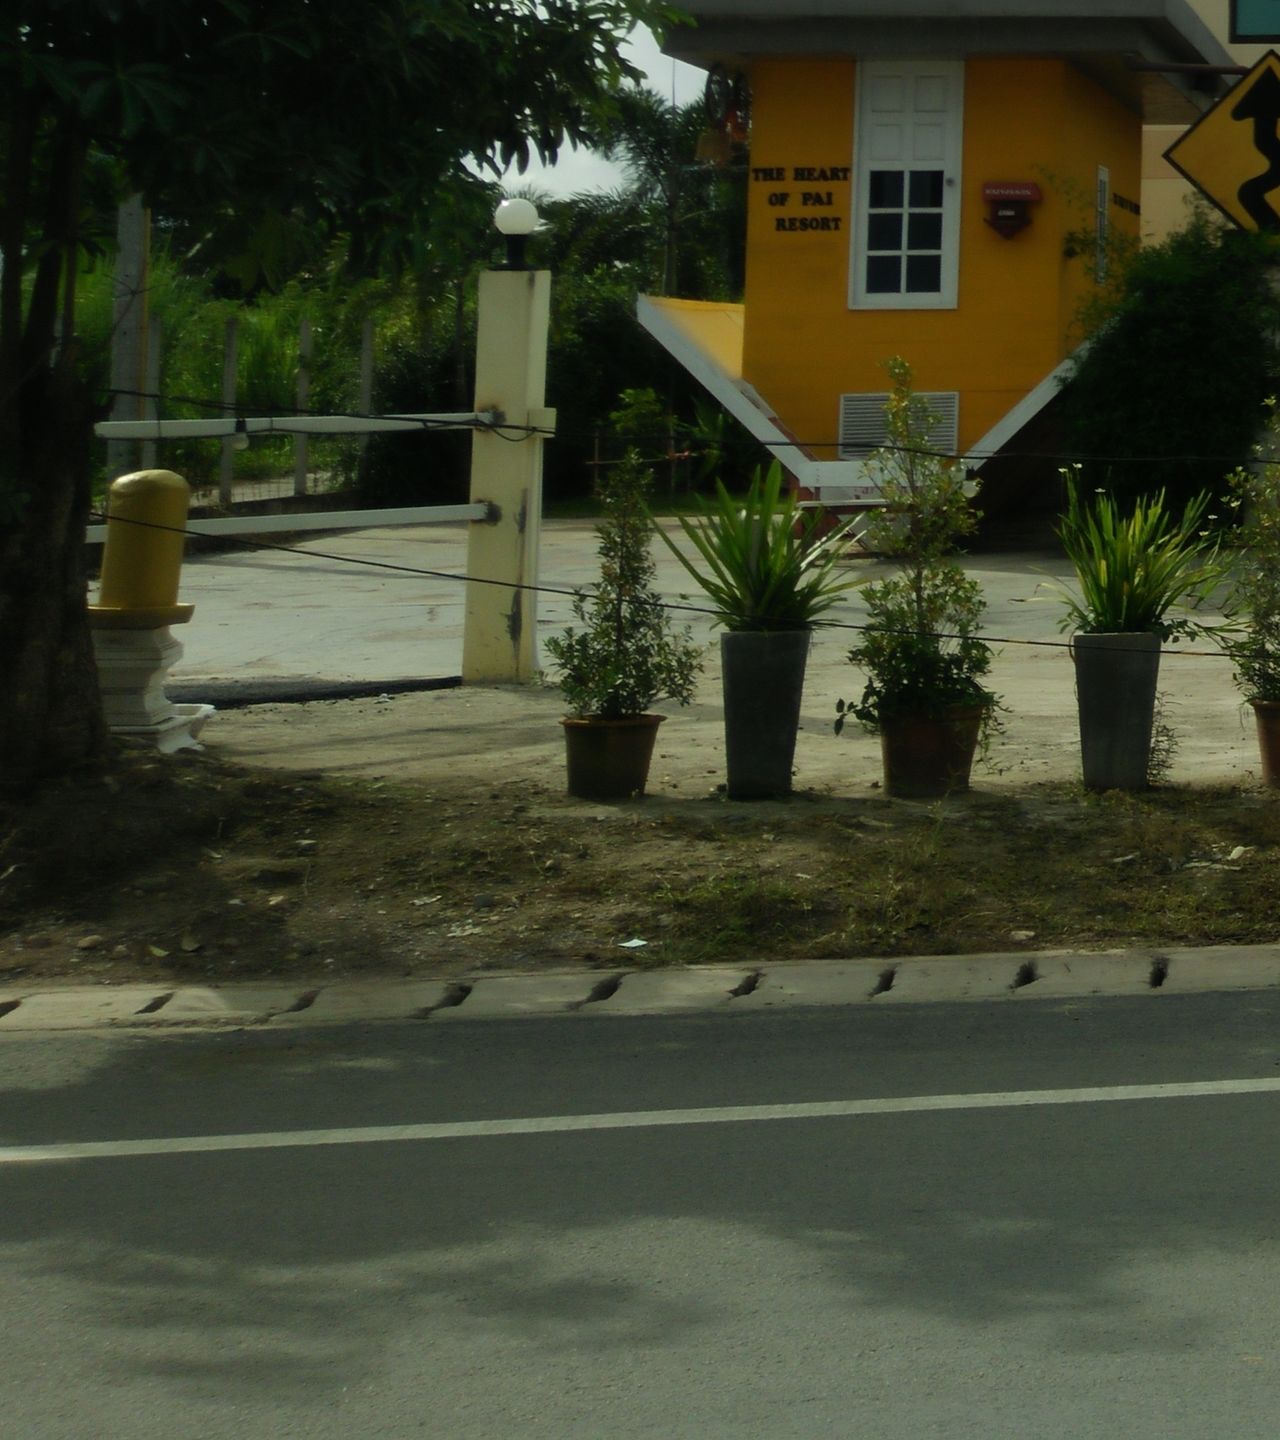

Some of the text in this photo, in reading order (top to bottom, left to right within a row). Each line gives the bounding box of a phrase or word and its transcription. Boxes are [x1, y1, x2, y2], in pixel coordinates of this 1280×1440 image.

[752, 167, 850, 181] THE HEART
[768, 192, 833, 206] OF PAI
[775, 217, 842, 231] RESORT
